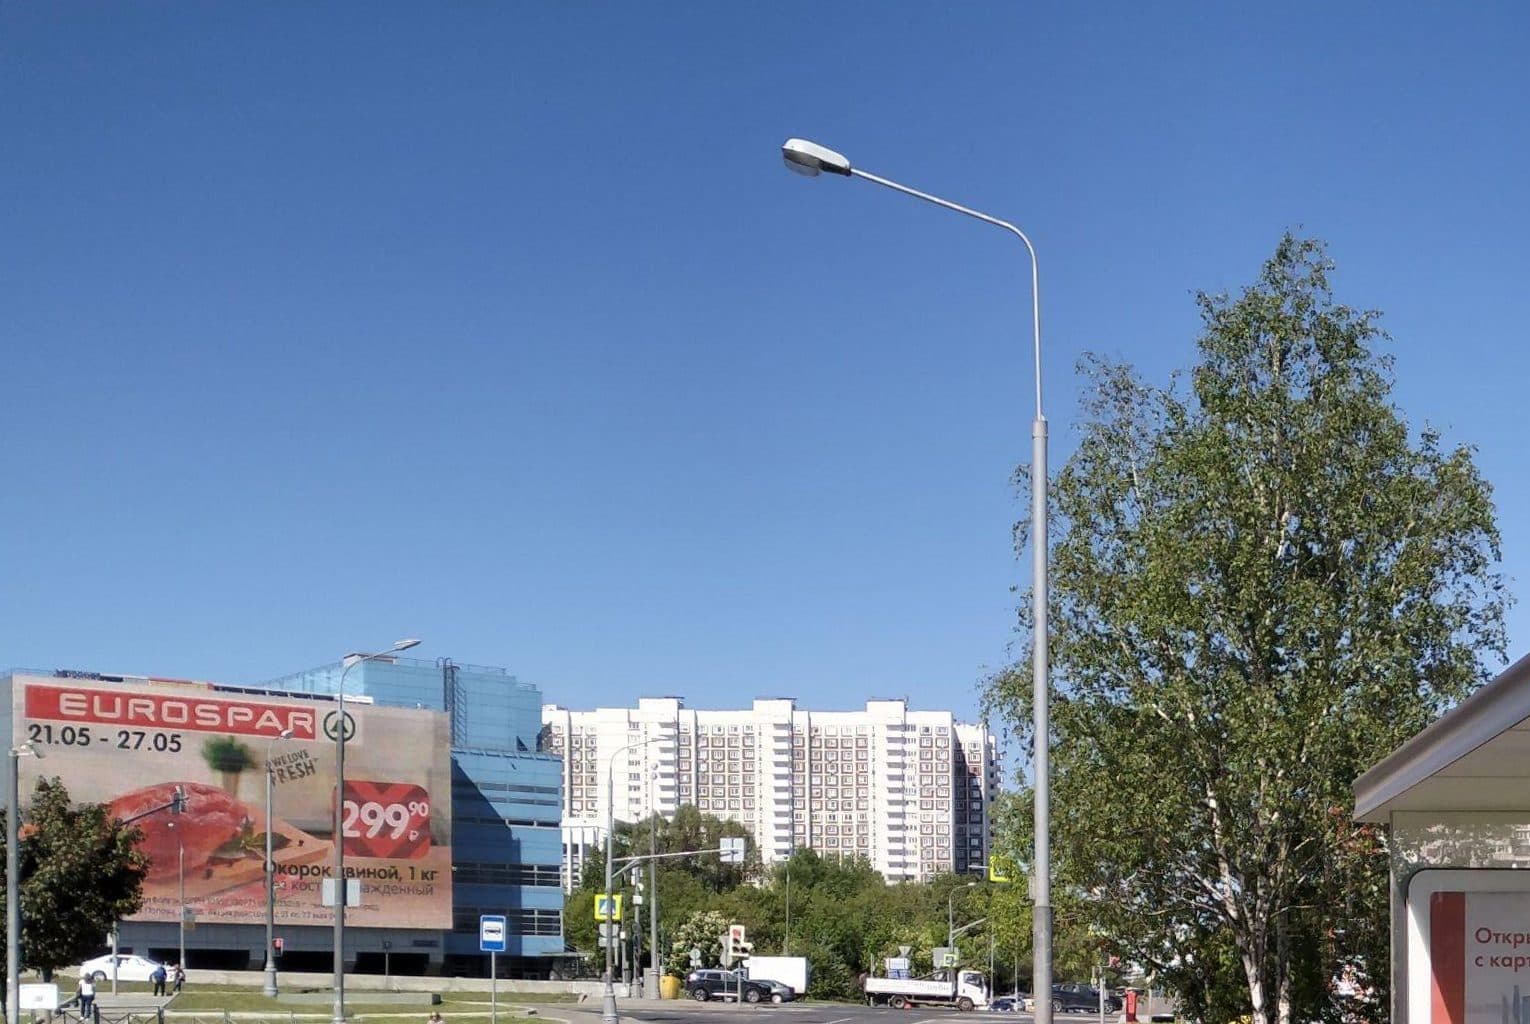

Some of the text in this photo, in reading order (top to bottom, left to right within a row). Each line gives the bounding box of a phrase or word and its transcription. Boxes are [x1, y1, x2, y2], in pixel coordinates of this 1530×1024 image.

[58, 692, 314, 734] EUROSPAR
[28, 724, 91, 747] 21.05
[117, 730, 182, 753] 27.05
[342, 800, 429, 840] 299 90
[263, 860, 439, 882] Окорок виной, 1 кг
[1475, 955, 1484, 967] с
